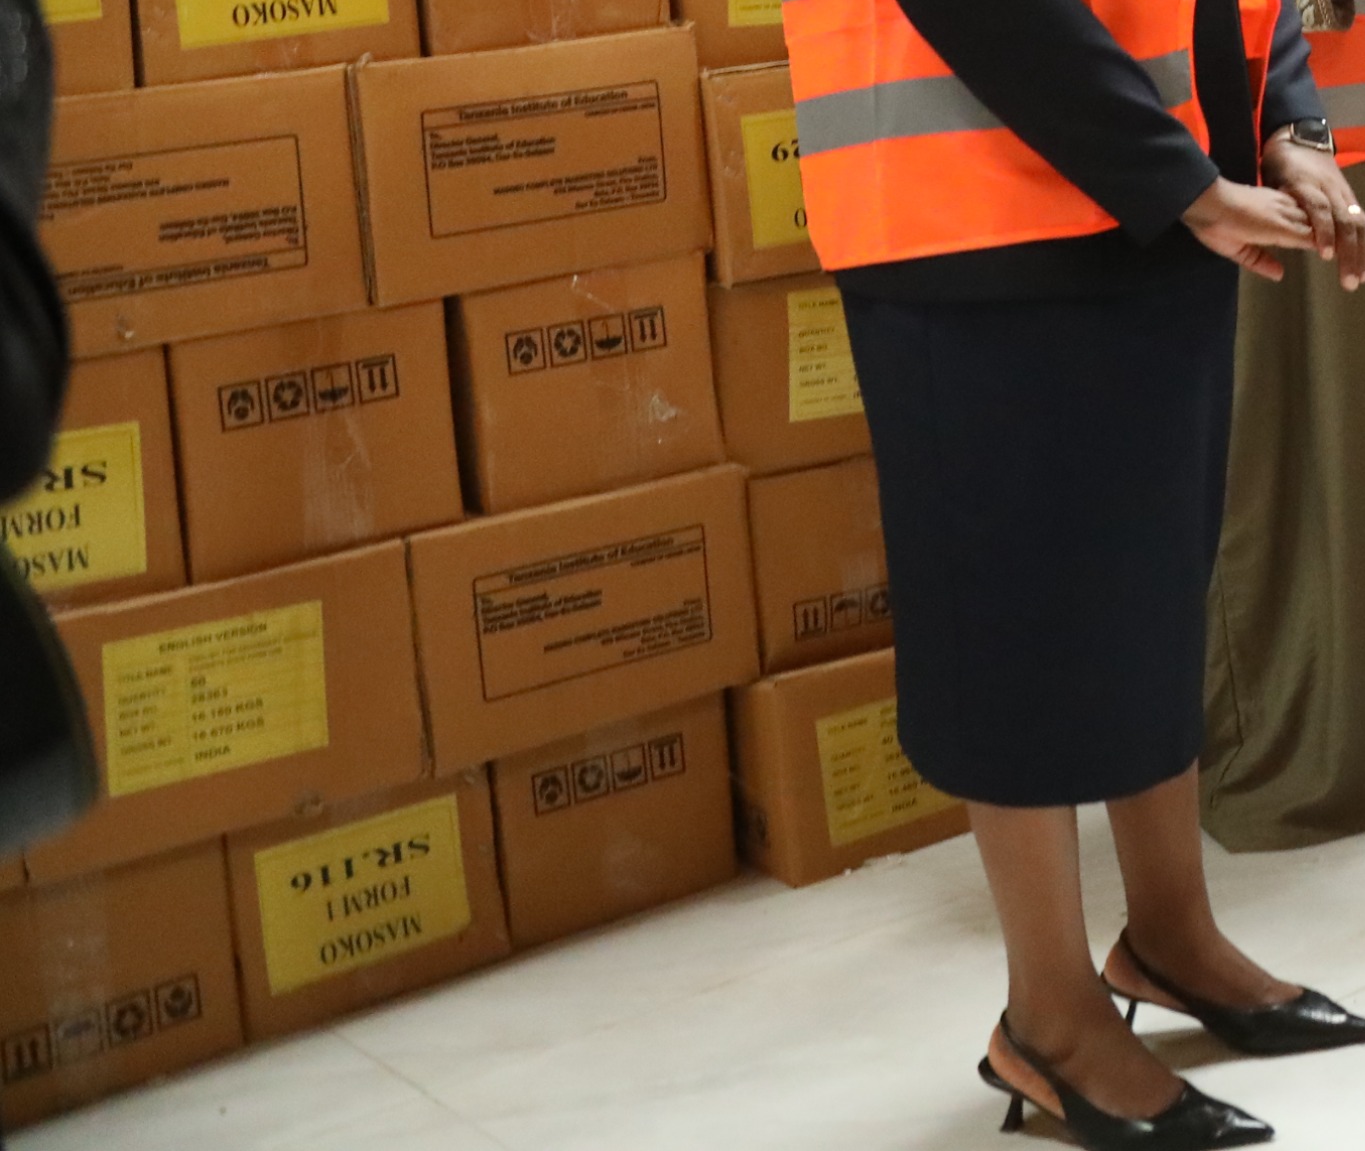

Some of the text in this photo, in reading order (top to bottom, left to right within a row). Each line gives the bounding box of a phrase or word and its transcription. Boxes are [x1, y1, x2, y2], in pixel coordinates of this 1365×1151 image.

[560, 96, 572, 109] of
[290, 831, 431, 894] SR.116
[326, 874, 412, 923] FORM 1
[319, 913, 422, 965] MASOKO
